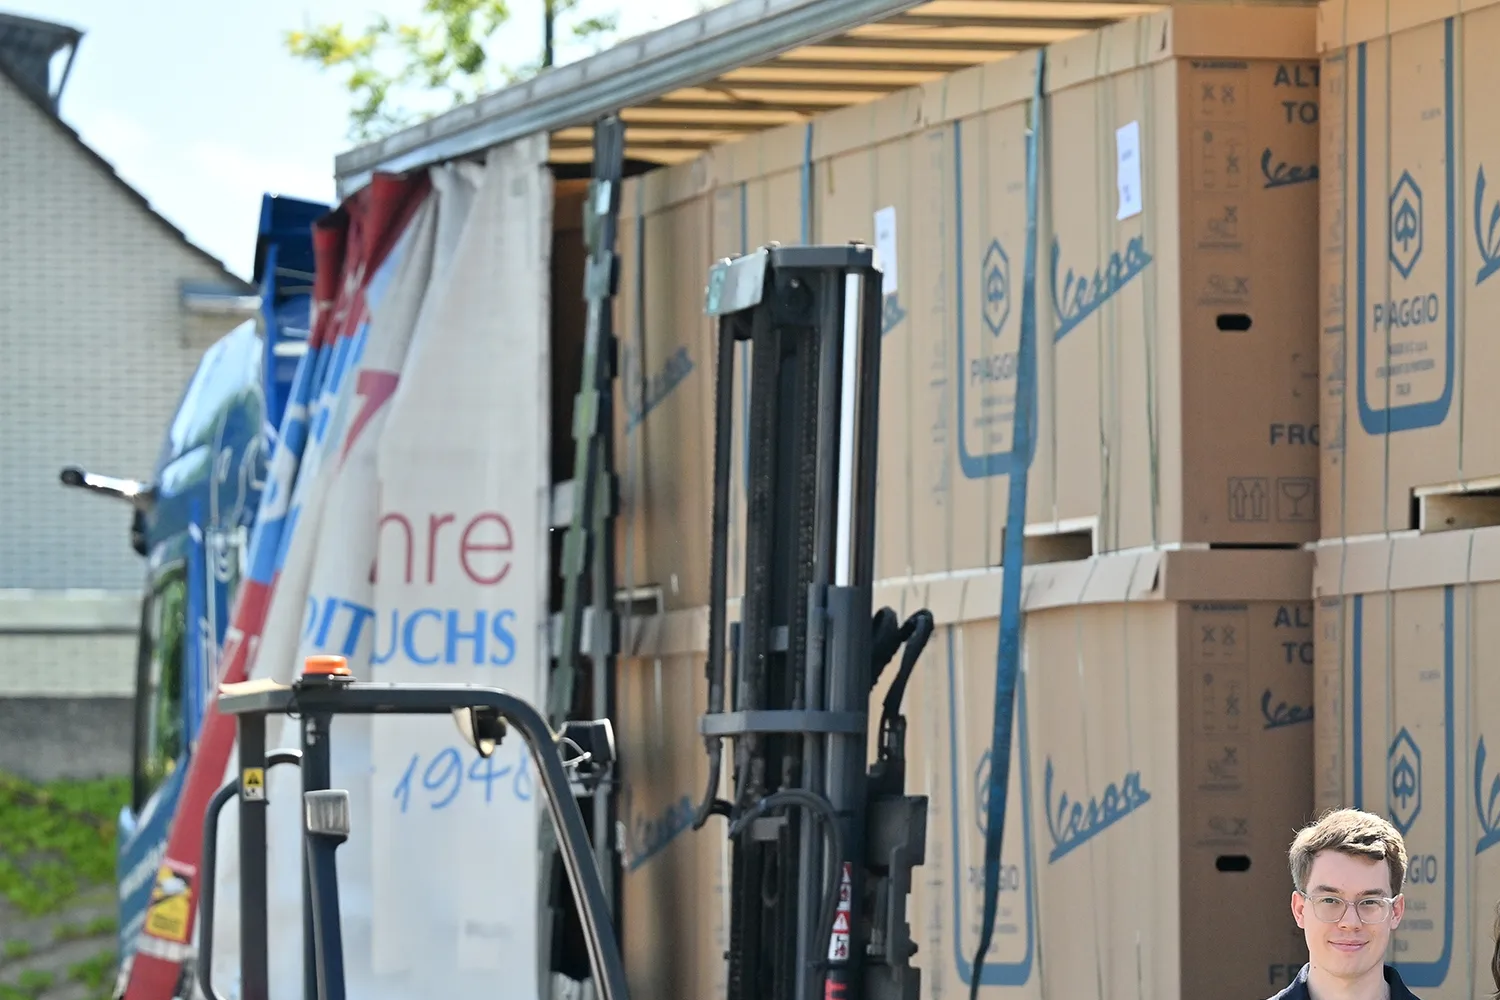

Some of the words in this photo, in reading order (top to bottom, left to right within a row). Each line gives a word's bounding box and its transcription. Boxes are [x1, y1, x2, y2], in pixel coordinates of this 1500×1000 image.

[1281, 101, 1319, 124] TO
[1050, 235, 1152, 343] Vespa
[1044, 755, 1151, 864] Vespa
